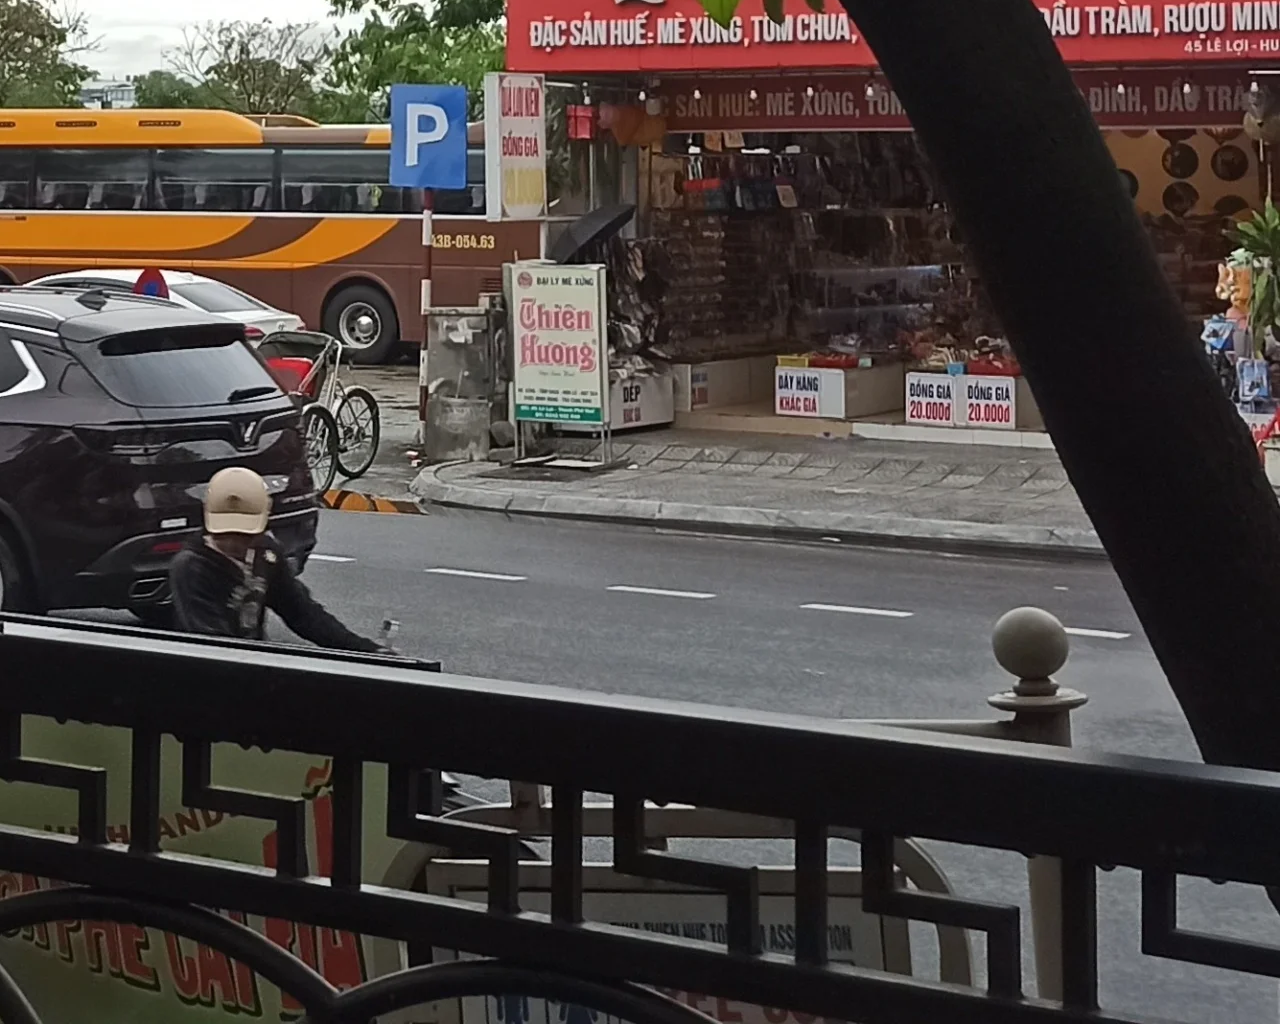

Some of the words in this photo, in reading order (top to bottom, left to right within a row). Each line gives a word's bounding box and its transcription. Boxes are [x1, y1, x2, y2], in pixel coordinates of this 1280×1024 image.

[530, 14, 567, 53] ĐẶC
[570, 11, 610, 47] SẢN
[657, 12, 686, 45] MÈ
[796, 12, 858, 44] CHUA,
[1164, 1, 1226, 40] RƯỢU
[1231, 0, 1280, 32] MIN
[1184, 39, 1203, 53] 45
[1206, 36, 1222, 53] LÊ
[405, 103, 449, 167] P
[936, 381, 952, 400] GIÁ
[995, 383, 1011, 402] GIÁ
